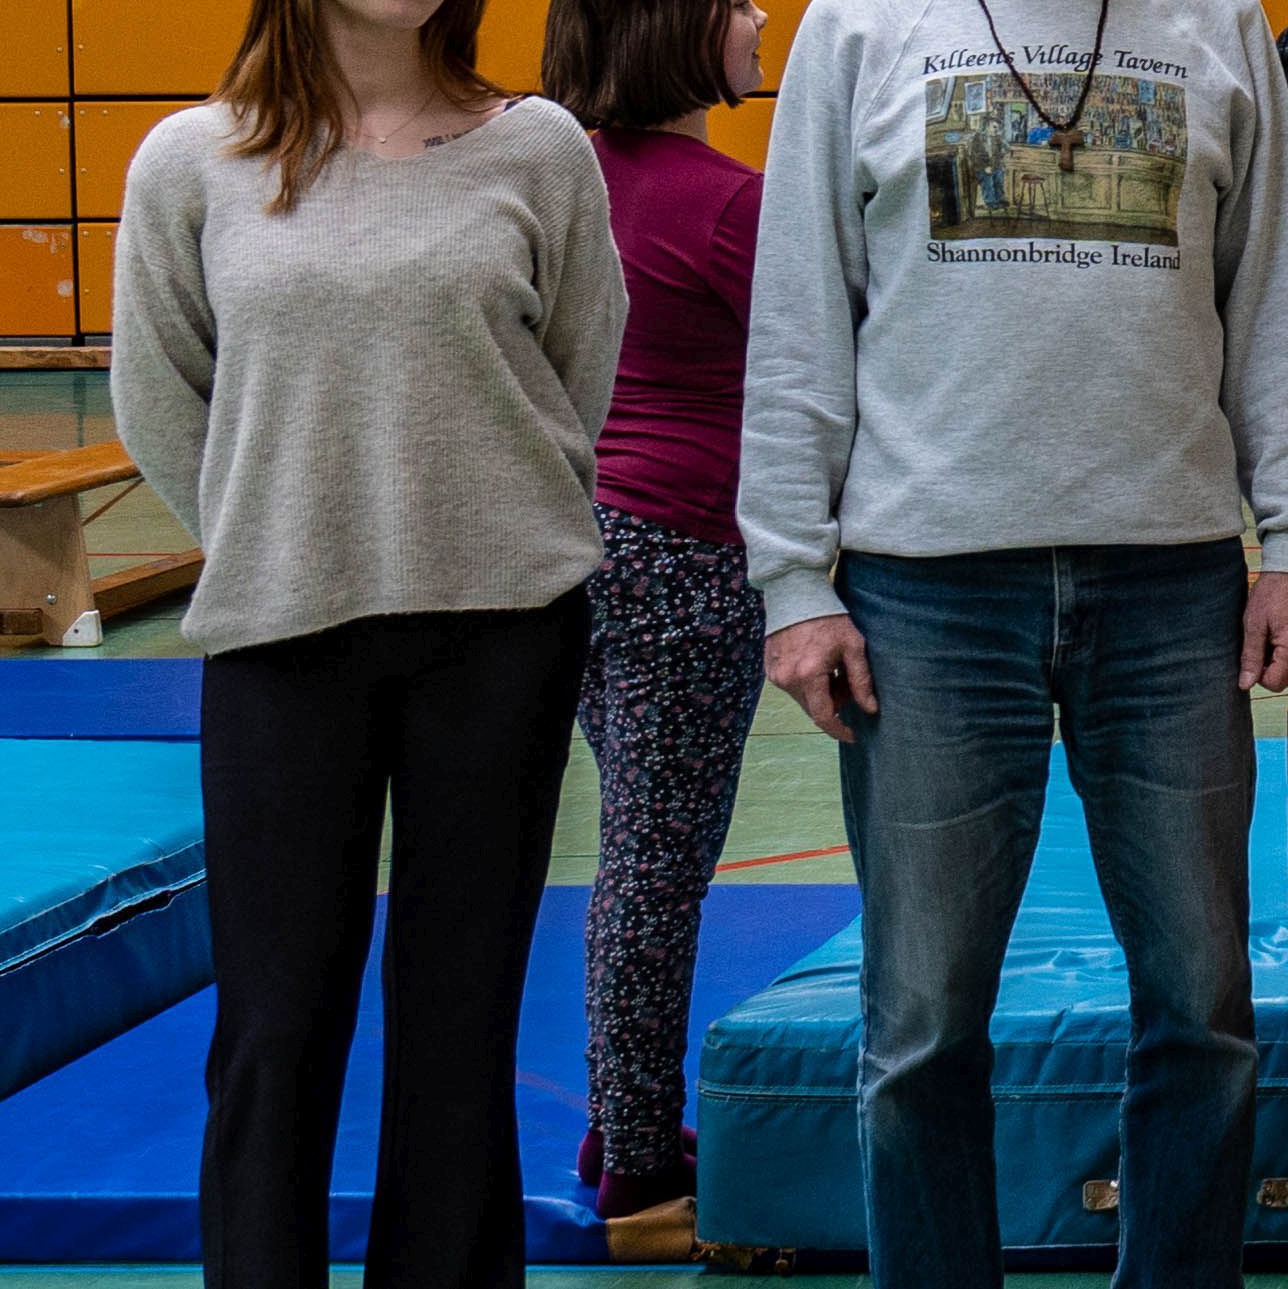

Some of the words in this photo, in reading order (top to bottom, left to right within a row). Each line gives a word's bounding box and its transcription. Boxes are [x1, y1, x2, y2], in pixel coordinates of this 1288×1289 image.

[1022, 44, 1104, 72] Village
[1113, 50, 1189, 79] Tavern
[926, 242, 1103, 269] Shannonbridge
[1111, 244, 1181, 270] Ireland
